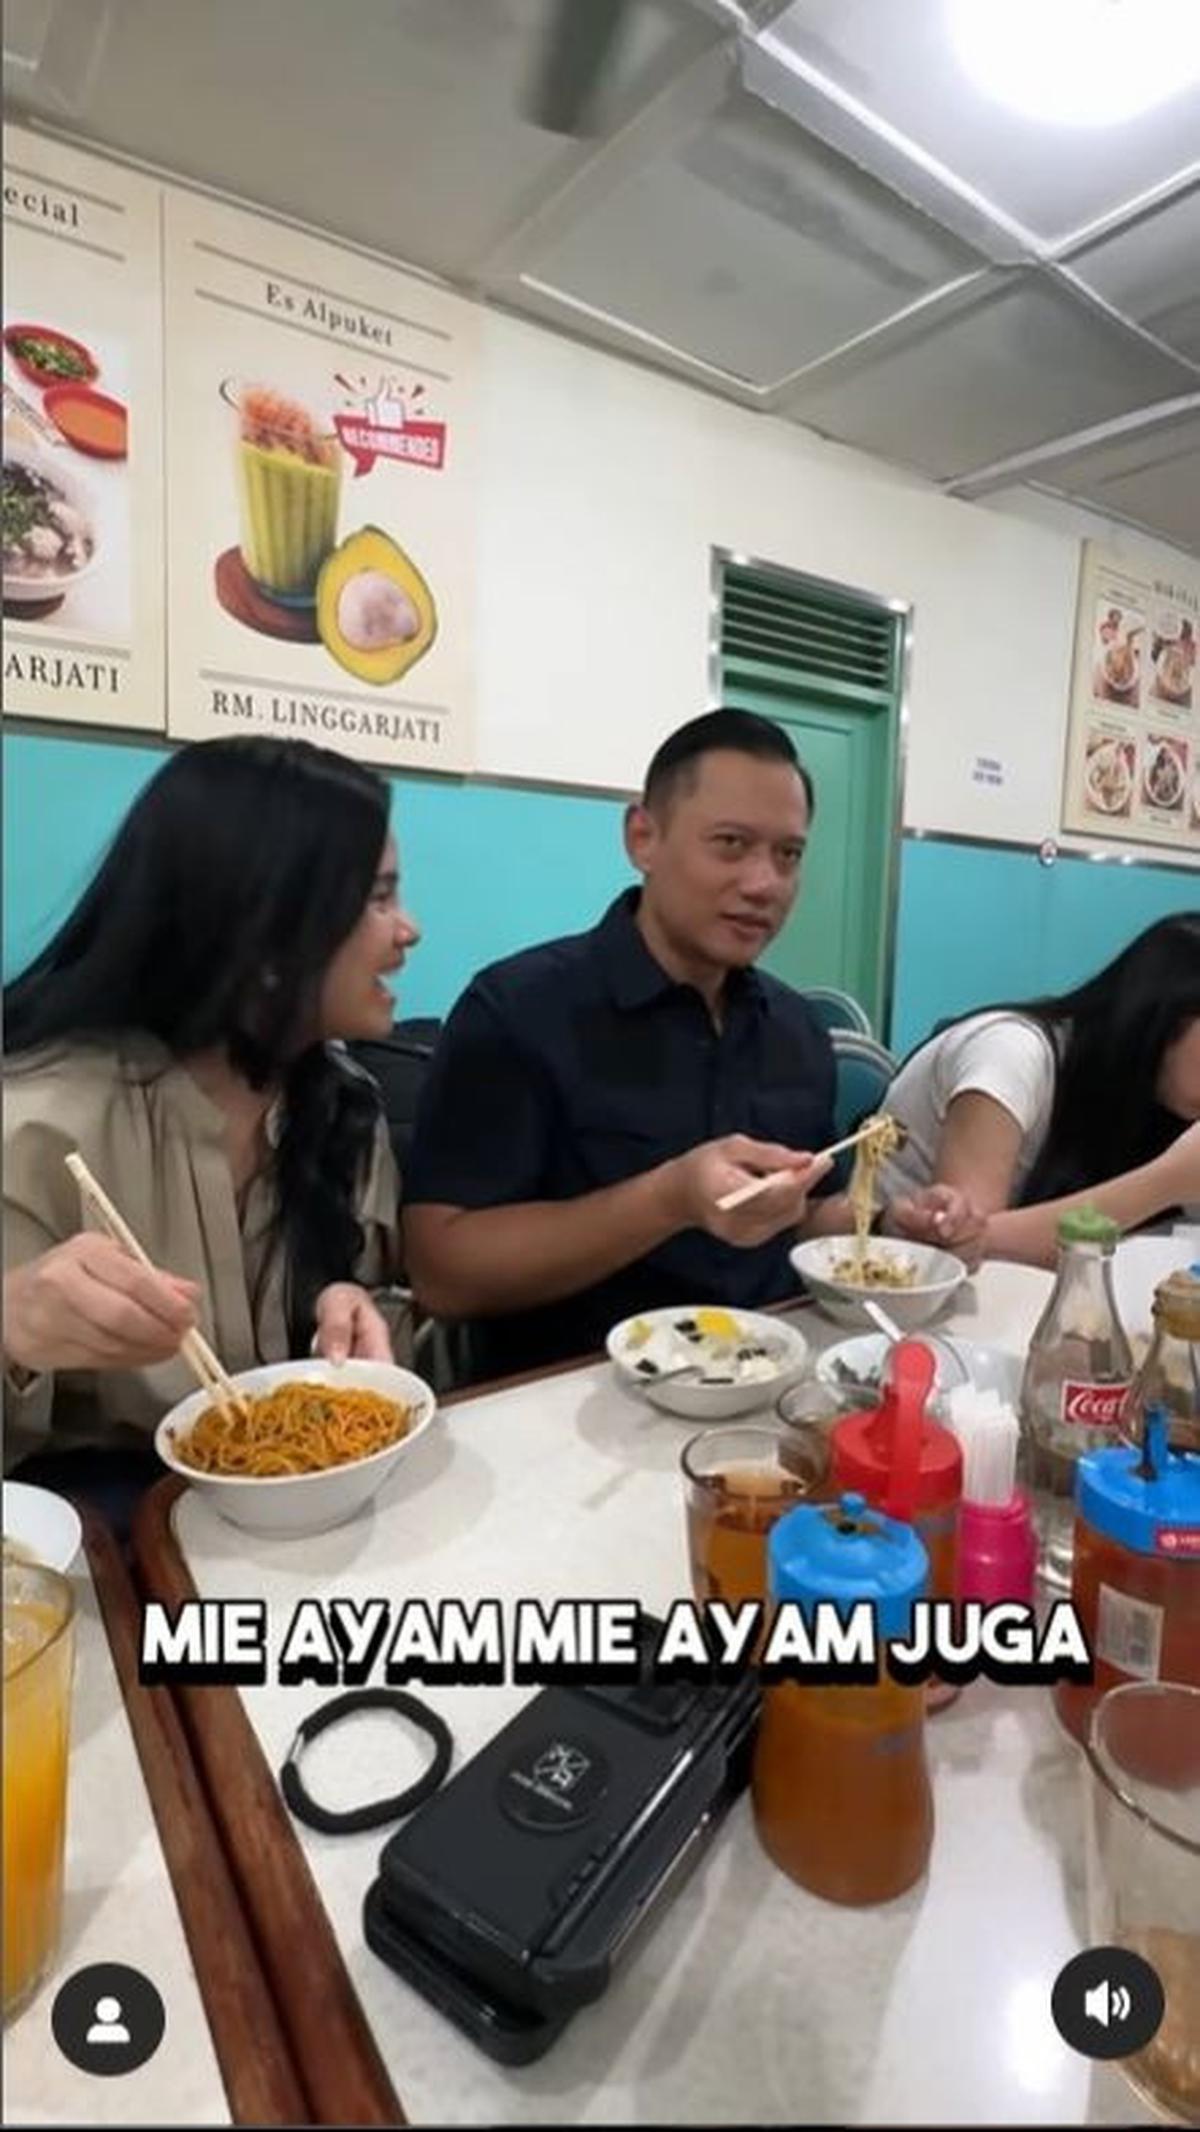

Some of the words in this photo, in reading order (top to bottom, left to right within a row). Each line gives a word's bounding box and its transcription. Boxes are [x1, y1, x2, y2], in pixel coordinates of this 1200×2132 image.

[267, 281, 295, 311] Es
[303, 297, 393, 347] Alpuket
[4, 653, 119, 694] ARJATI
[211, 689, 264, 721] RM.
[272, 697, 441, 744] LINGGARJATI
